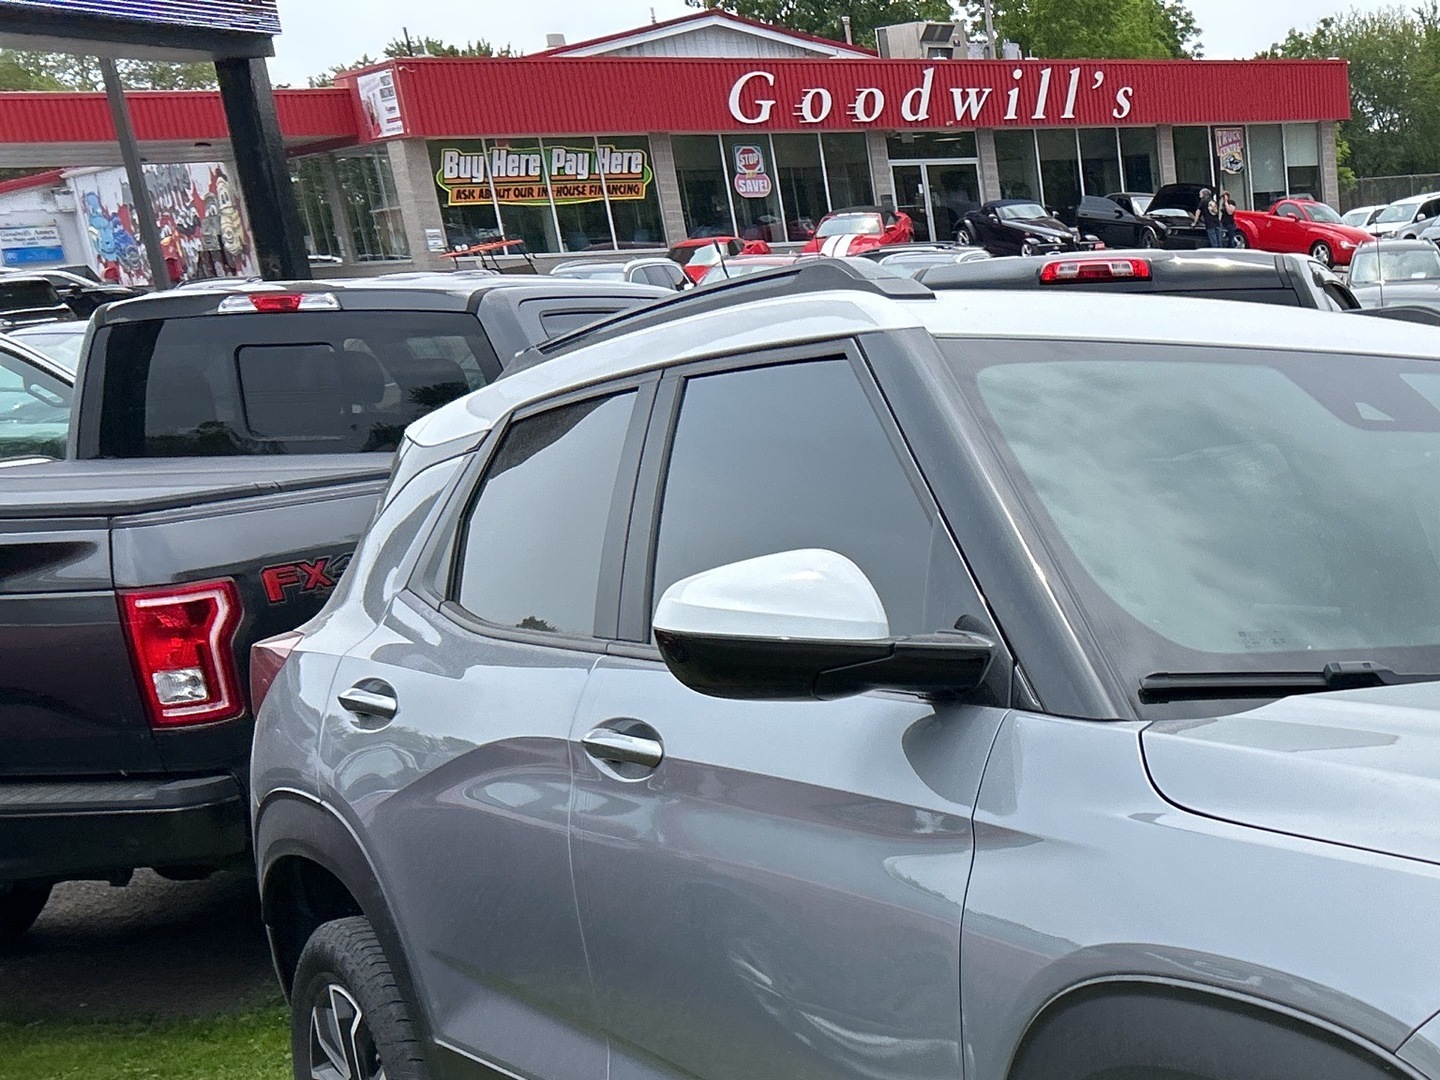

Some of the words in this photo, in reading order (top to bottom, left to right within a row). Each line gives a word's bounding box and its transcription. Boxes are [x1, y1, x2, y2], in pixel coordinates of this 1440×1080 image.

[728, 66, 1134, 125] Goodwill's
[443, 151, 485, 183] Buy
[491, 149, 541, 177] Here
[551, 148, 590, 180] Pay
[594, 147, 643, 174] Here
[739, 153, 760, 166] STOP
[455, 188, 476, 200] ASK
[478, 186, 512, 199] ABUT
[513, 186, 535, 198] OUR
[738, 179, 768, 193] SAVE!
